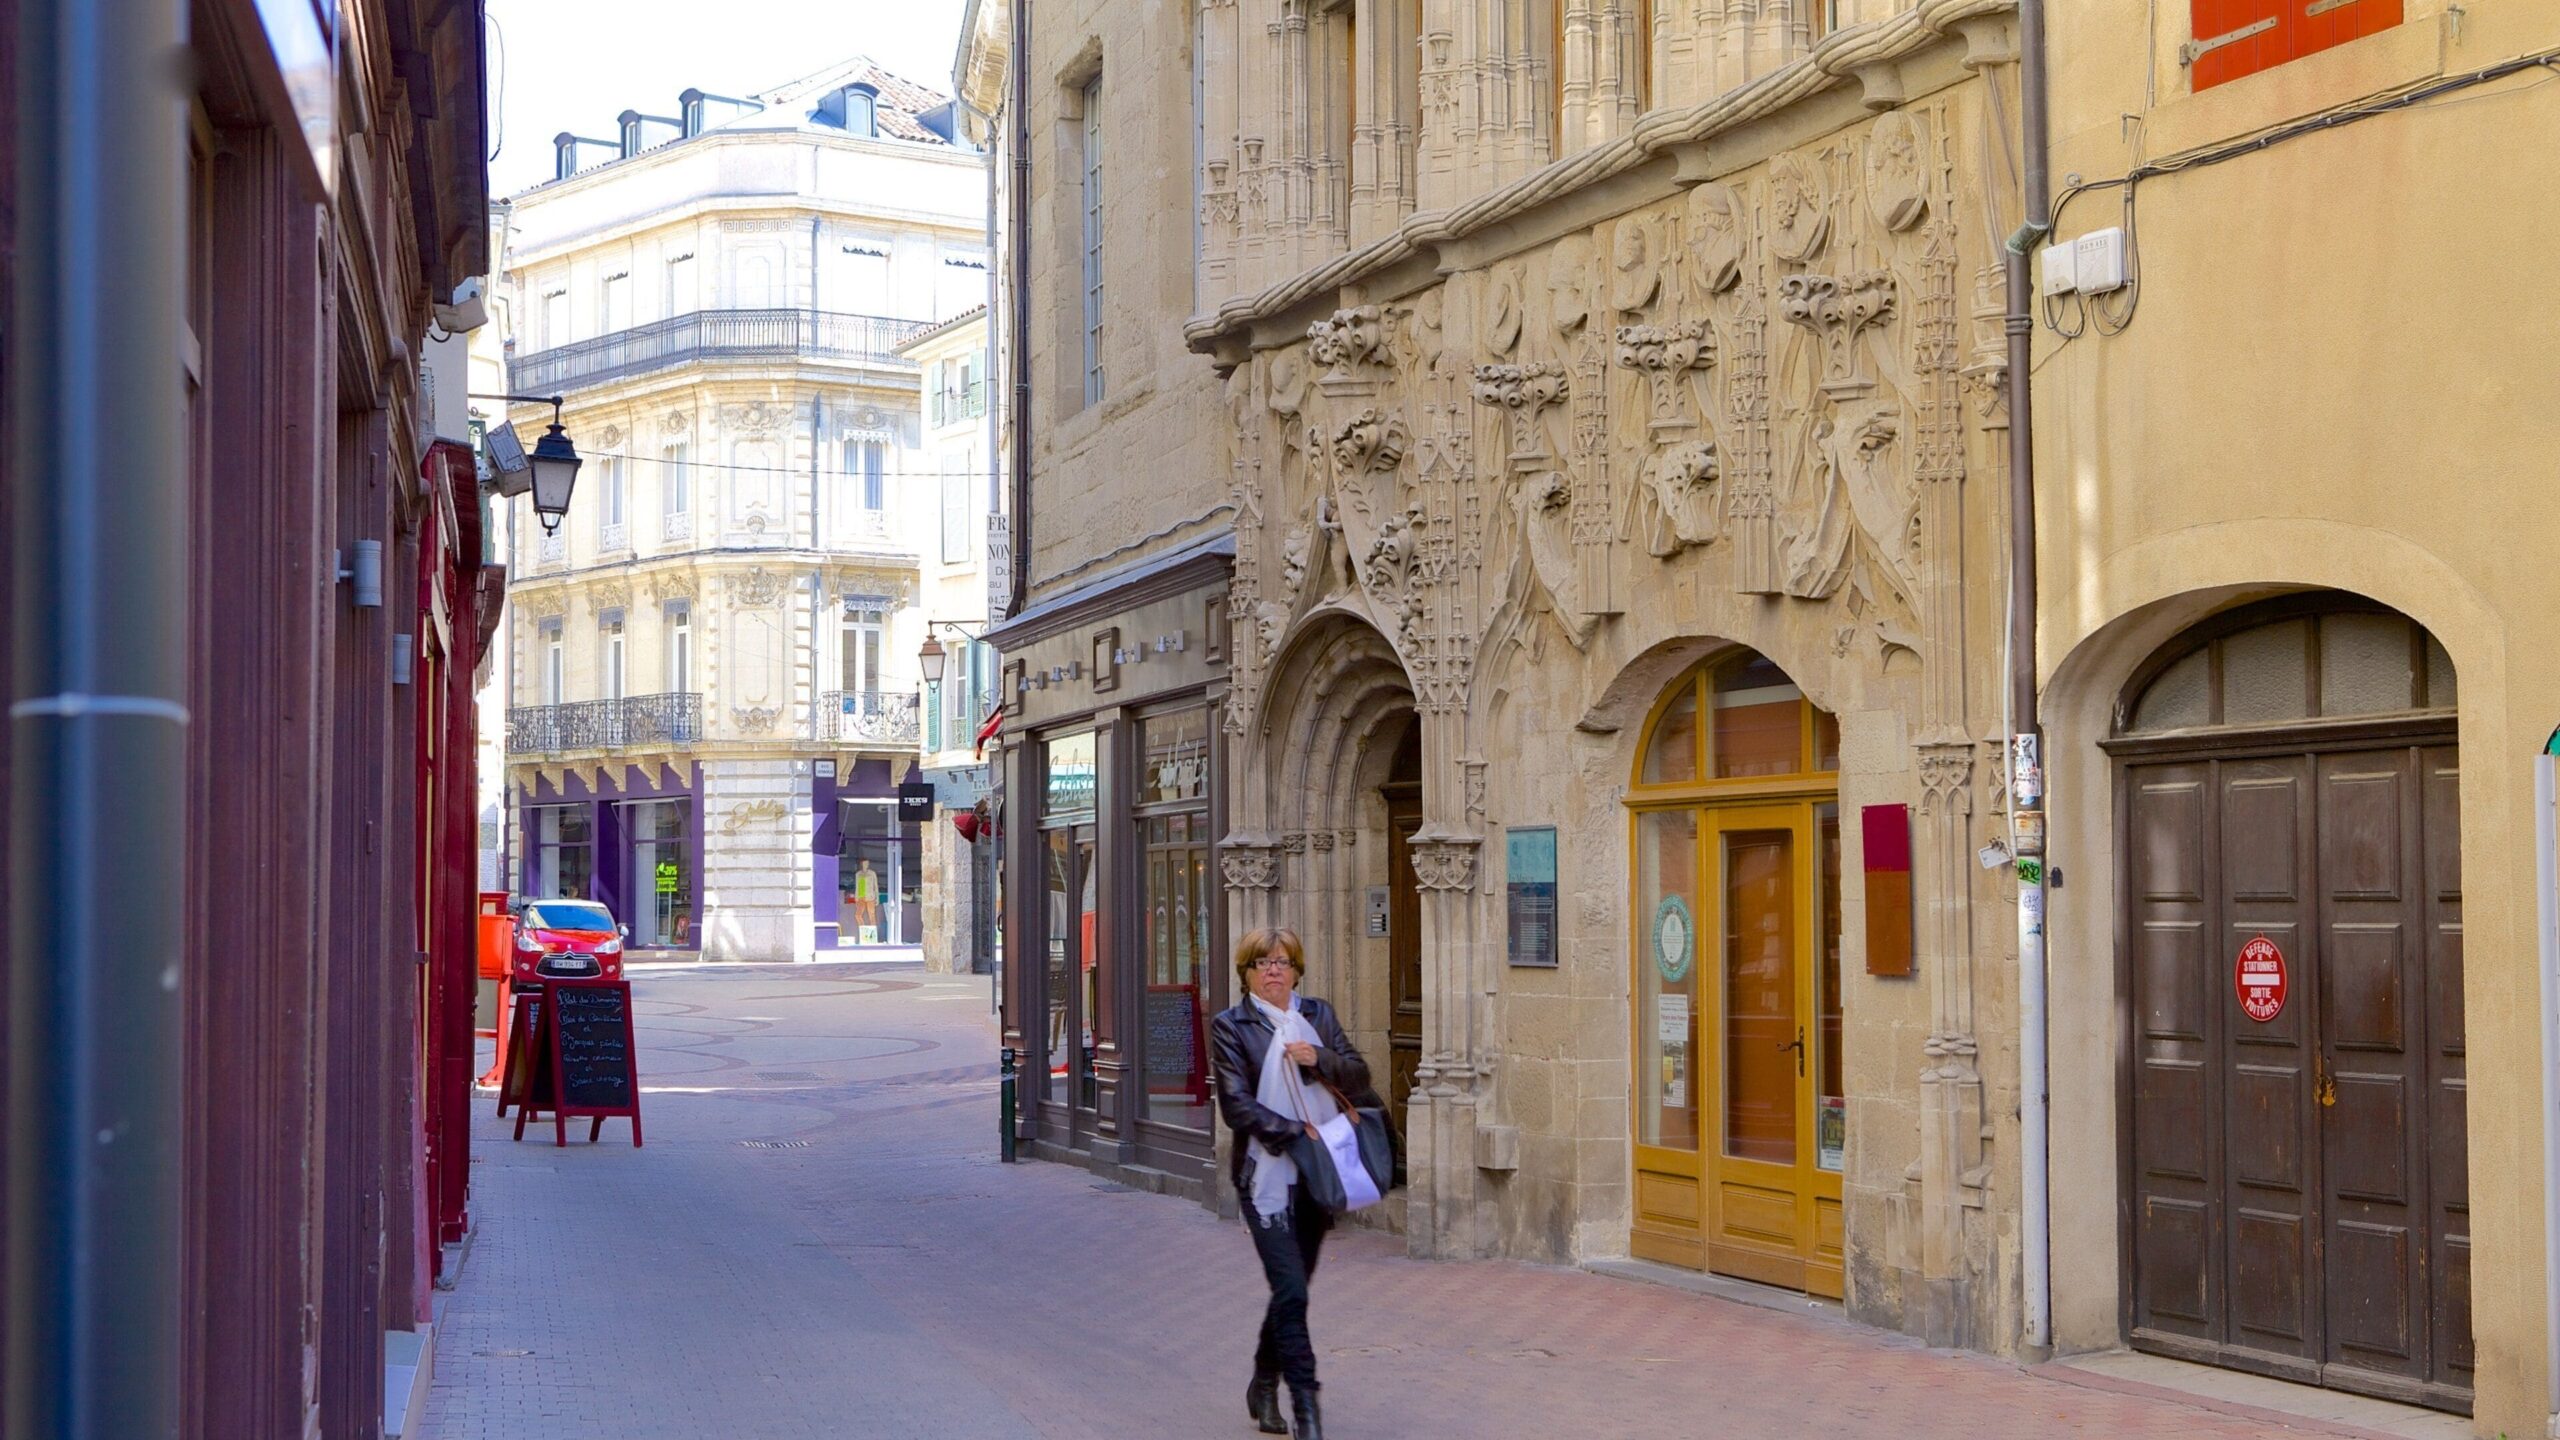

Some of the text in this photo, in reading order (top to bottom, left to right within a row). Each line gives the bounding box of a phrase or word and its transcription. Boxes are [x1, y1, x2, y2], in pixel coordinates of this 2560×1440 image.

[2244, 961, 2278, 972] STATIONNER
[2250, 986, 2272, 998] SORTIE
[2246, 998, 2279, 1017] VOITURES
